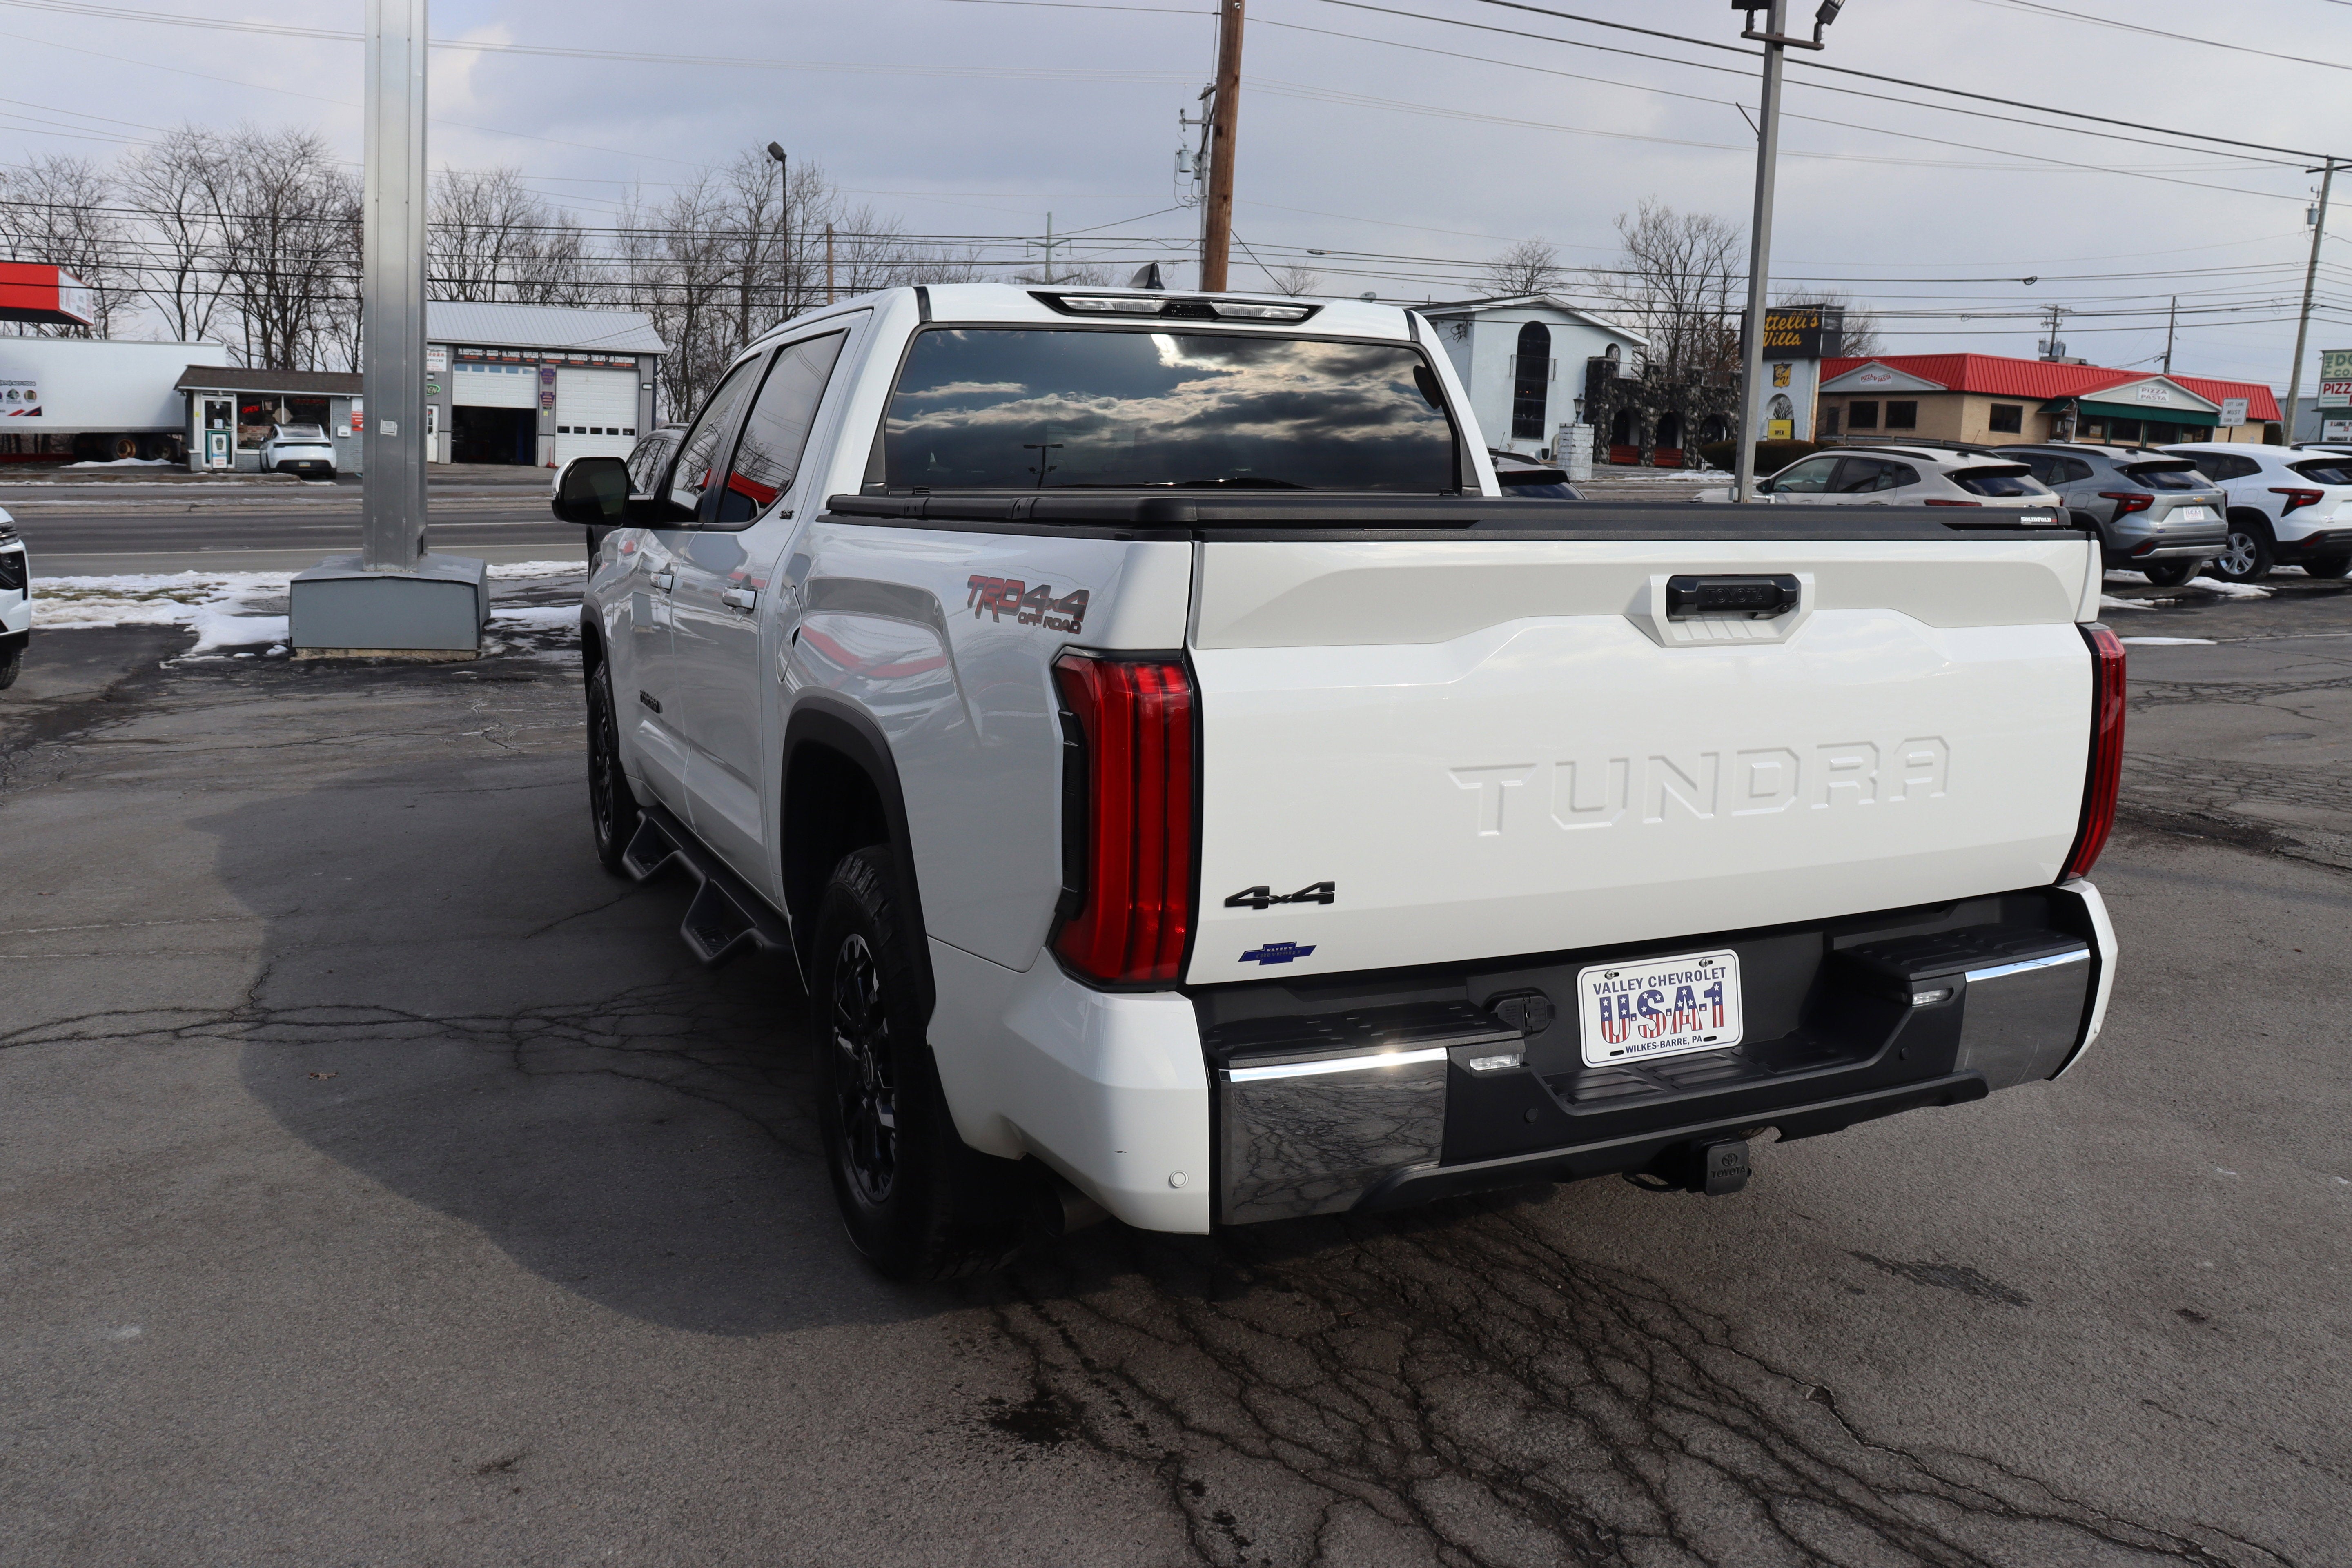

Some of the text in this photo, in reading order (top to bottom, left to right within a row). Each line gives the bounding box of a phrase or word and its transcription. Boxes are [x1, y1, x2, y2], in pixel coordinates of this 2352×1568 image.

[1764, 308, 1819, 330] ttelli's
[1763, 331, 1802, 347] Villa
[1878, 374, 1891, 383] PASTA
[2334, 368, 2352, 376] CO
[2323, 383, 2352, 394] PIZZ
[967, 575, 1025, 623] TRD
[1705, 588, 1766, 603] TOYOTA
[1018, 612, 1082, 634] OFF ROAD
[1447, 735, 1950, 836] TUNDRA
[1225, 881, 1335, 909] 4x4
[1256, 950, 1301, 958] CHEVROLET
[1593, 967, 1726, 995] VALLEY CHEVROLET
[1625, 1038, 1690, 1054] WILKES-BARRE,
[1711, 1165, 1746, 1178] TOYOTA
